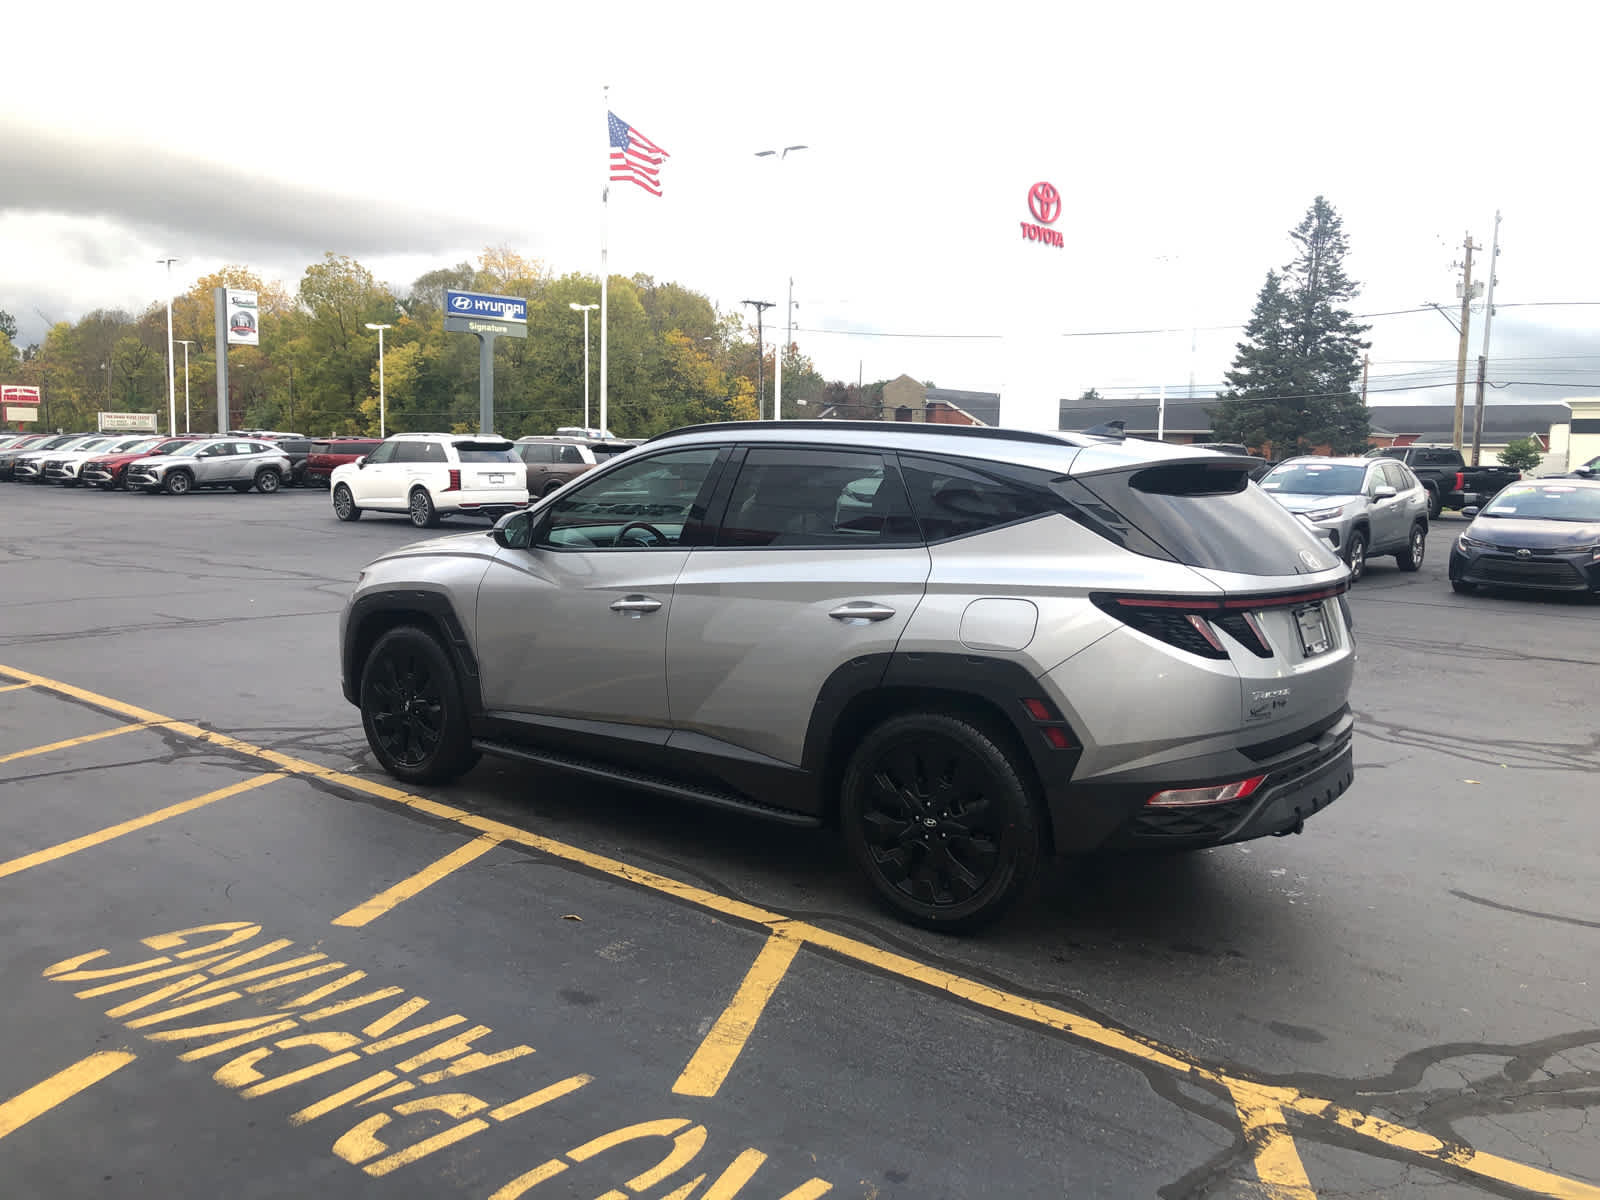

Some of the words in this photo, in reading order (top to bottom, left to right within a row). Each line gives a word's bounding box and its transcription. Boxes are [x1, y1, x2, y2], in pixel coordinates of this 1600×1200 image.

[1021, 222, 1064, 248] TOYOTA
[475, 300, 524, 314] HYUNDAI
[469, 322, 507, 333] Signature
[42, 921, 596, 1177] PARKING
